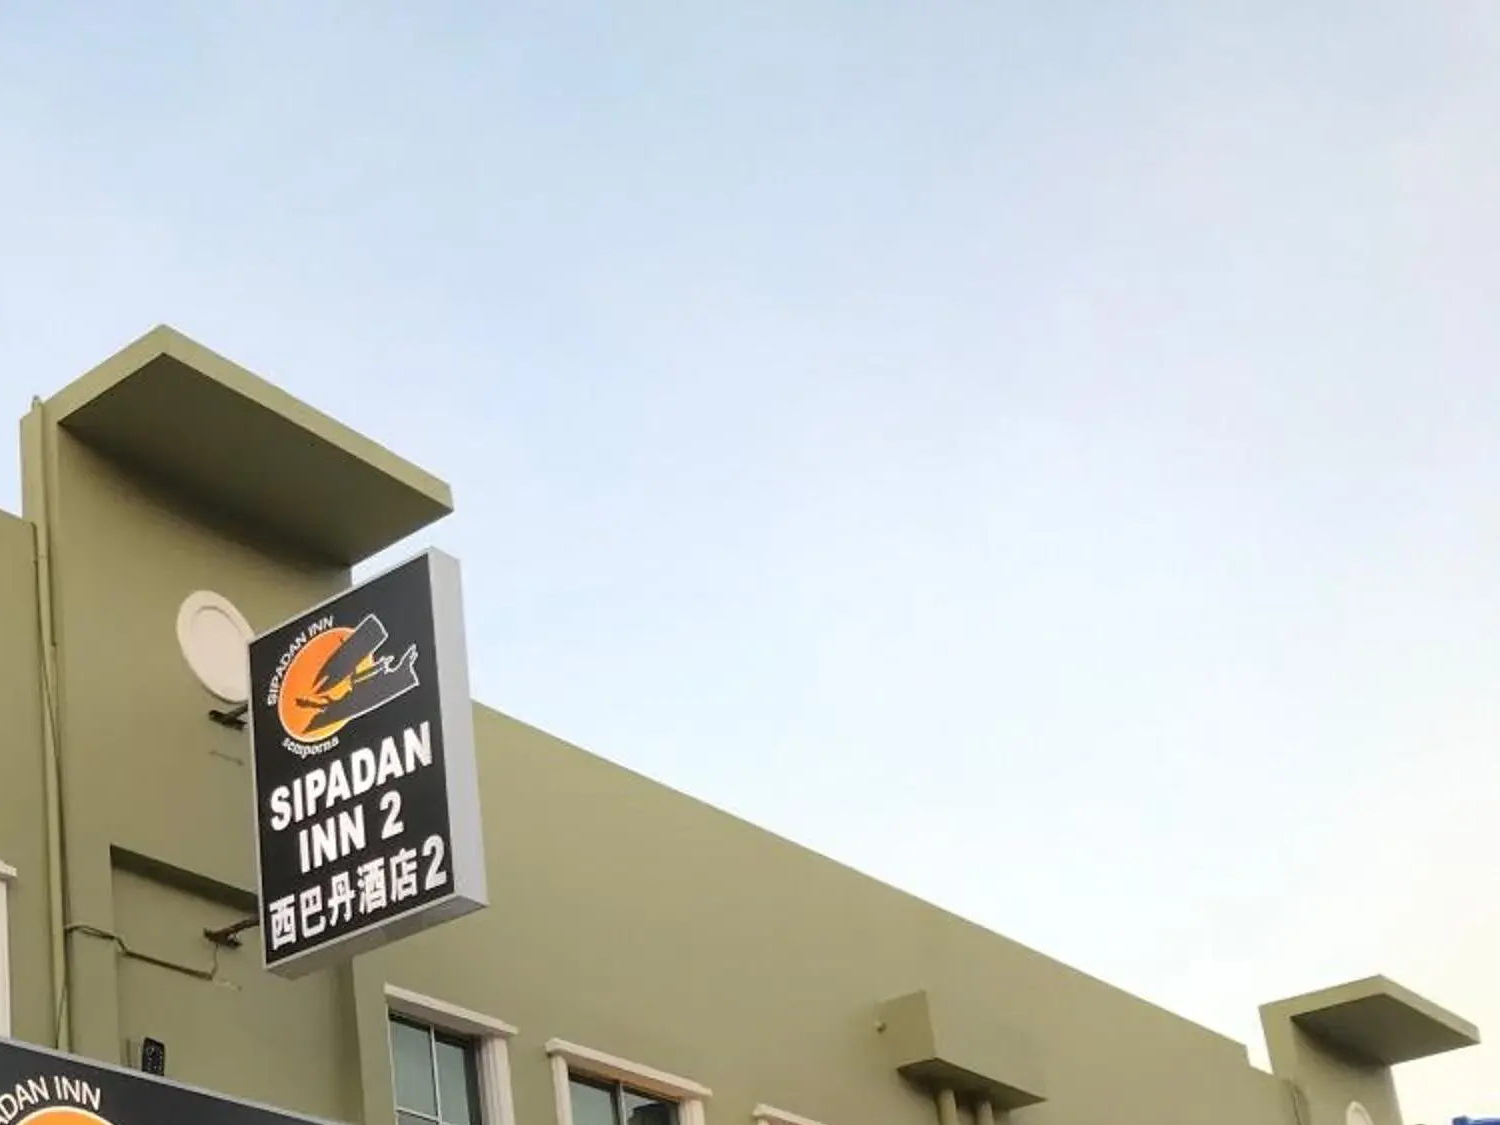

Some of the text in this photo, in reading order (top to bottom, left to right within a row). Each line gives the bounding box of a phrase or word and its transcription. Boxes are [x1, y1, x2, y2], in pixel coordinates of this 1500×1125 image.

[267, 615, 335, 706] SIPADAN INN
[269, 720, 434, 833] SIPADAN
[297, 789, 405, 874] INN 2
[53, 1075, 101, 1111] INN
